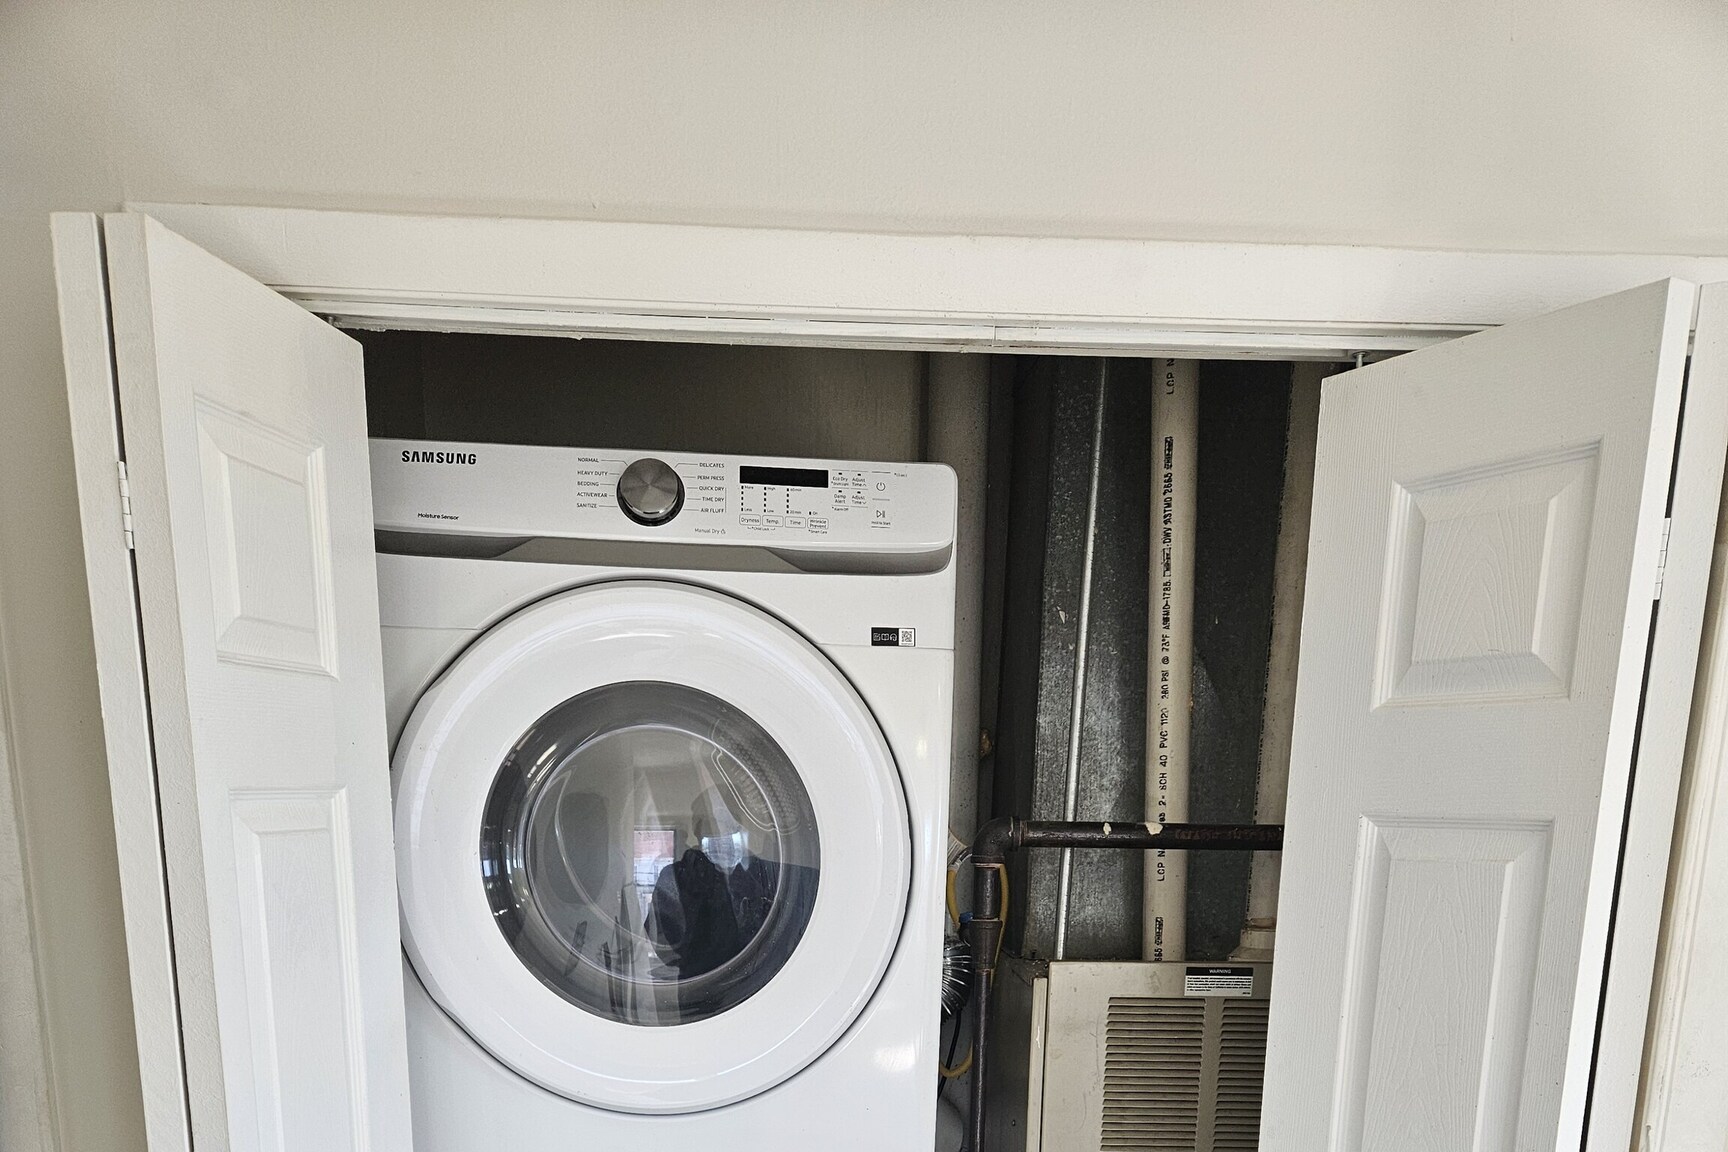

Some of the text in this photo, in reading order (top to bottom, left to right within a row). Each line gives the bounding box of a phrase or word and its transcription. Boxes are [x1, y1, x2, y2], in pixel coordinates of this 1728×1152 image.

[401, 450, 477, 465] SAMSUNG
[1159, 730, 1168, 748] PVC
[1159, 755, 1168, 767] 40
